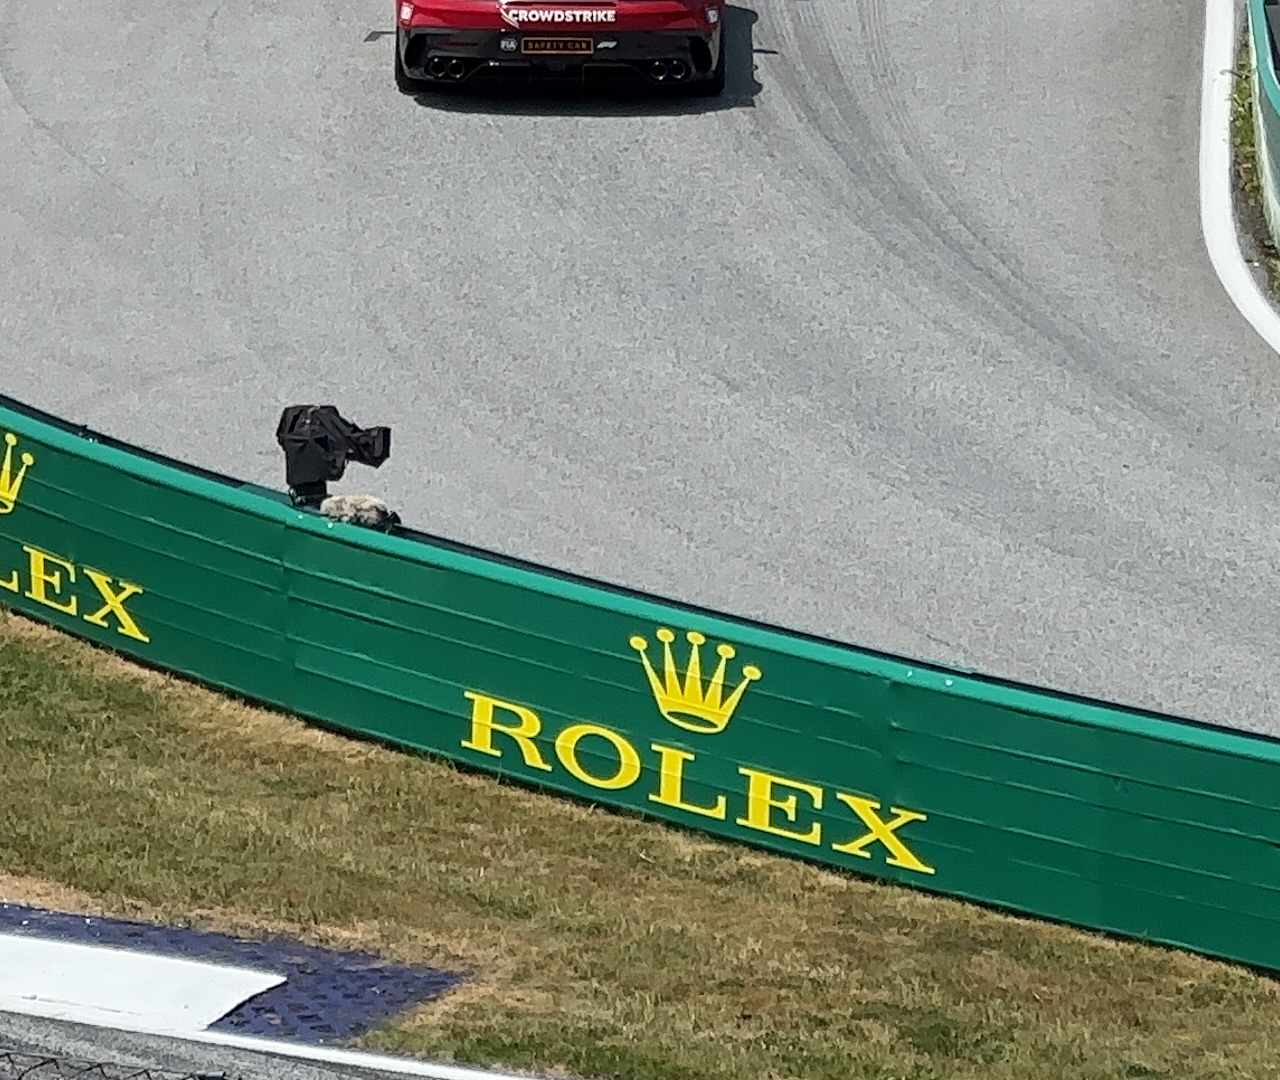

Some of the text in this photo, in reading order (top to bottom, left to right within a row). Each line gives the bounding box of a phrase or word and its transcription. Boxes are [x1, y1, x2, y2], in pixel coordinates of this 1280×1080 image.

[508, 10, 616, 23] CROWDSTRIKE
[527, 41, 588, 50] SAFETY CAR
[461, 690, 935, 875] ROLEX
